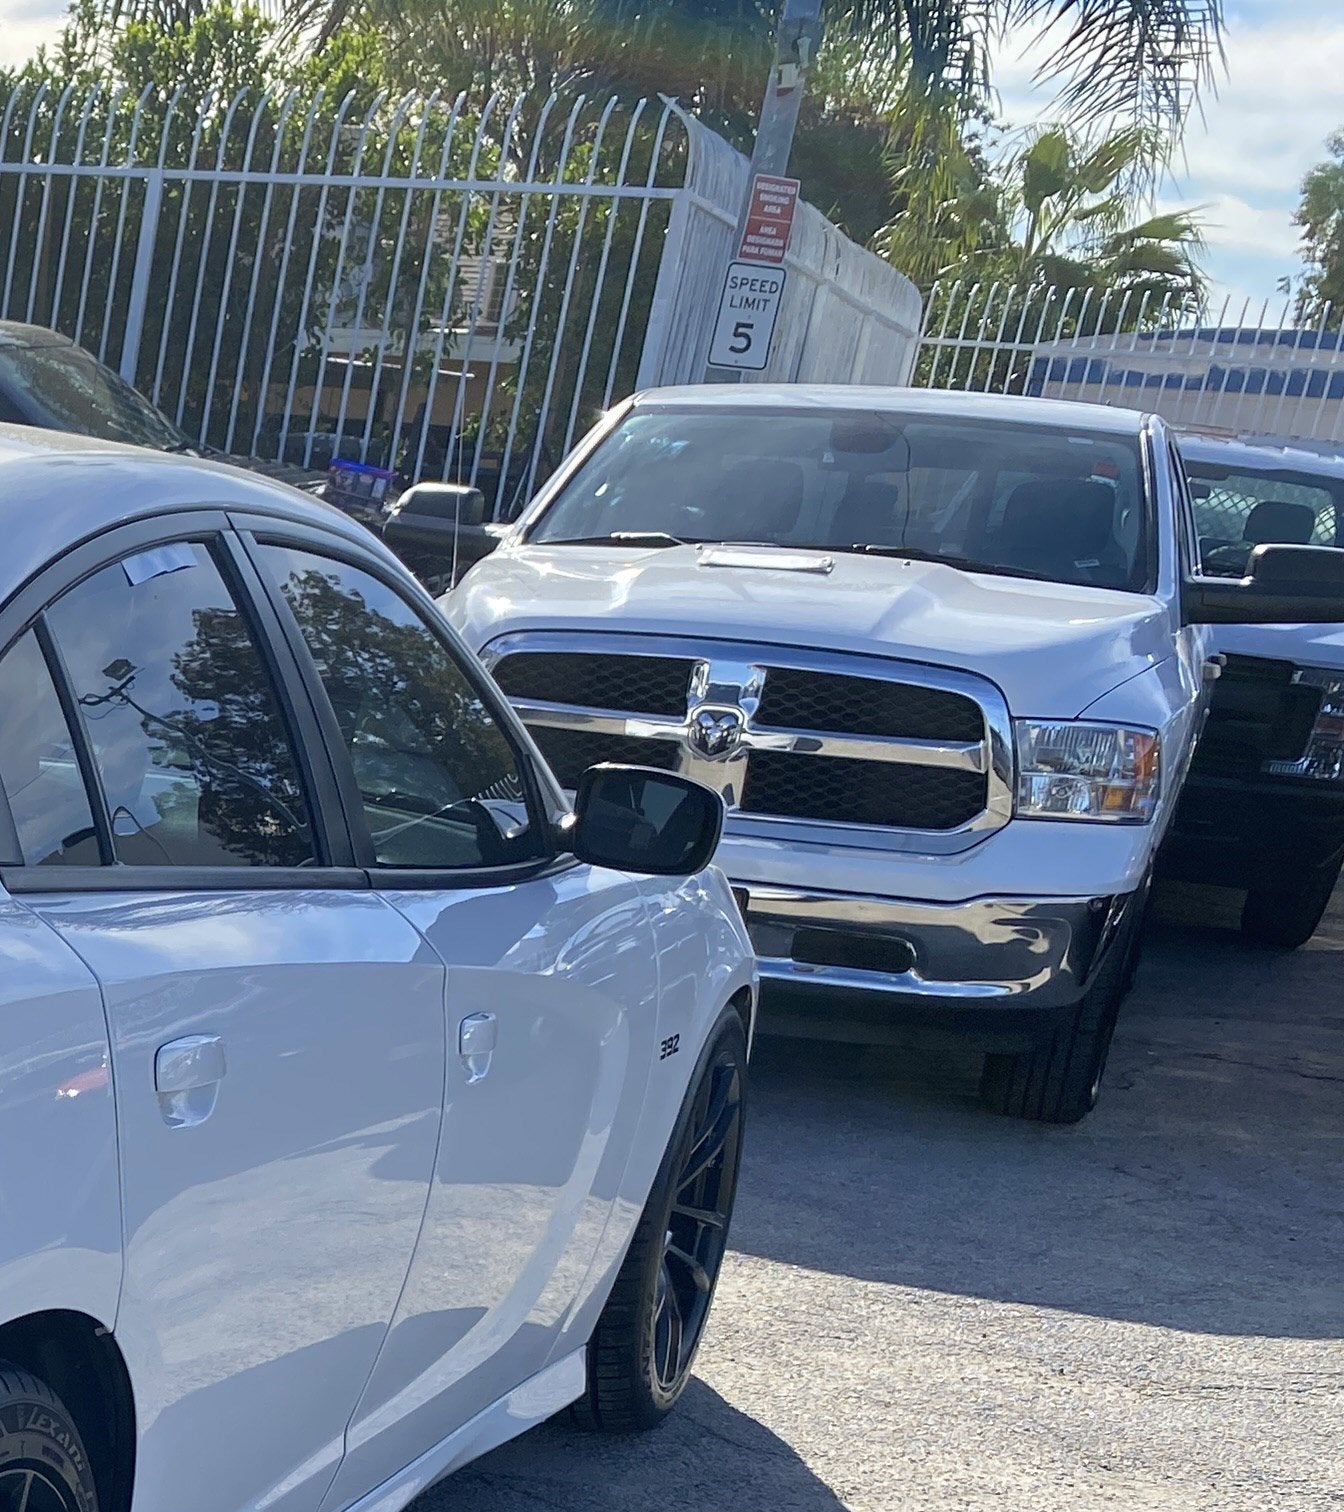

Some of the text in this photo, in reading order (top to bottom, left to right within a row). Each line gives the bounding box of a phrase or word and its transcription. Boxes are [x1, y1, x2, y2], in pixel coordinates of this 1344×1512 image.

[729, 275, 779, 295] SPEED
[729, 294, 771, 312] LIMIT
[728, 322, 755, 354] 5
[660, 1033, 680, 1061] 392
